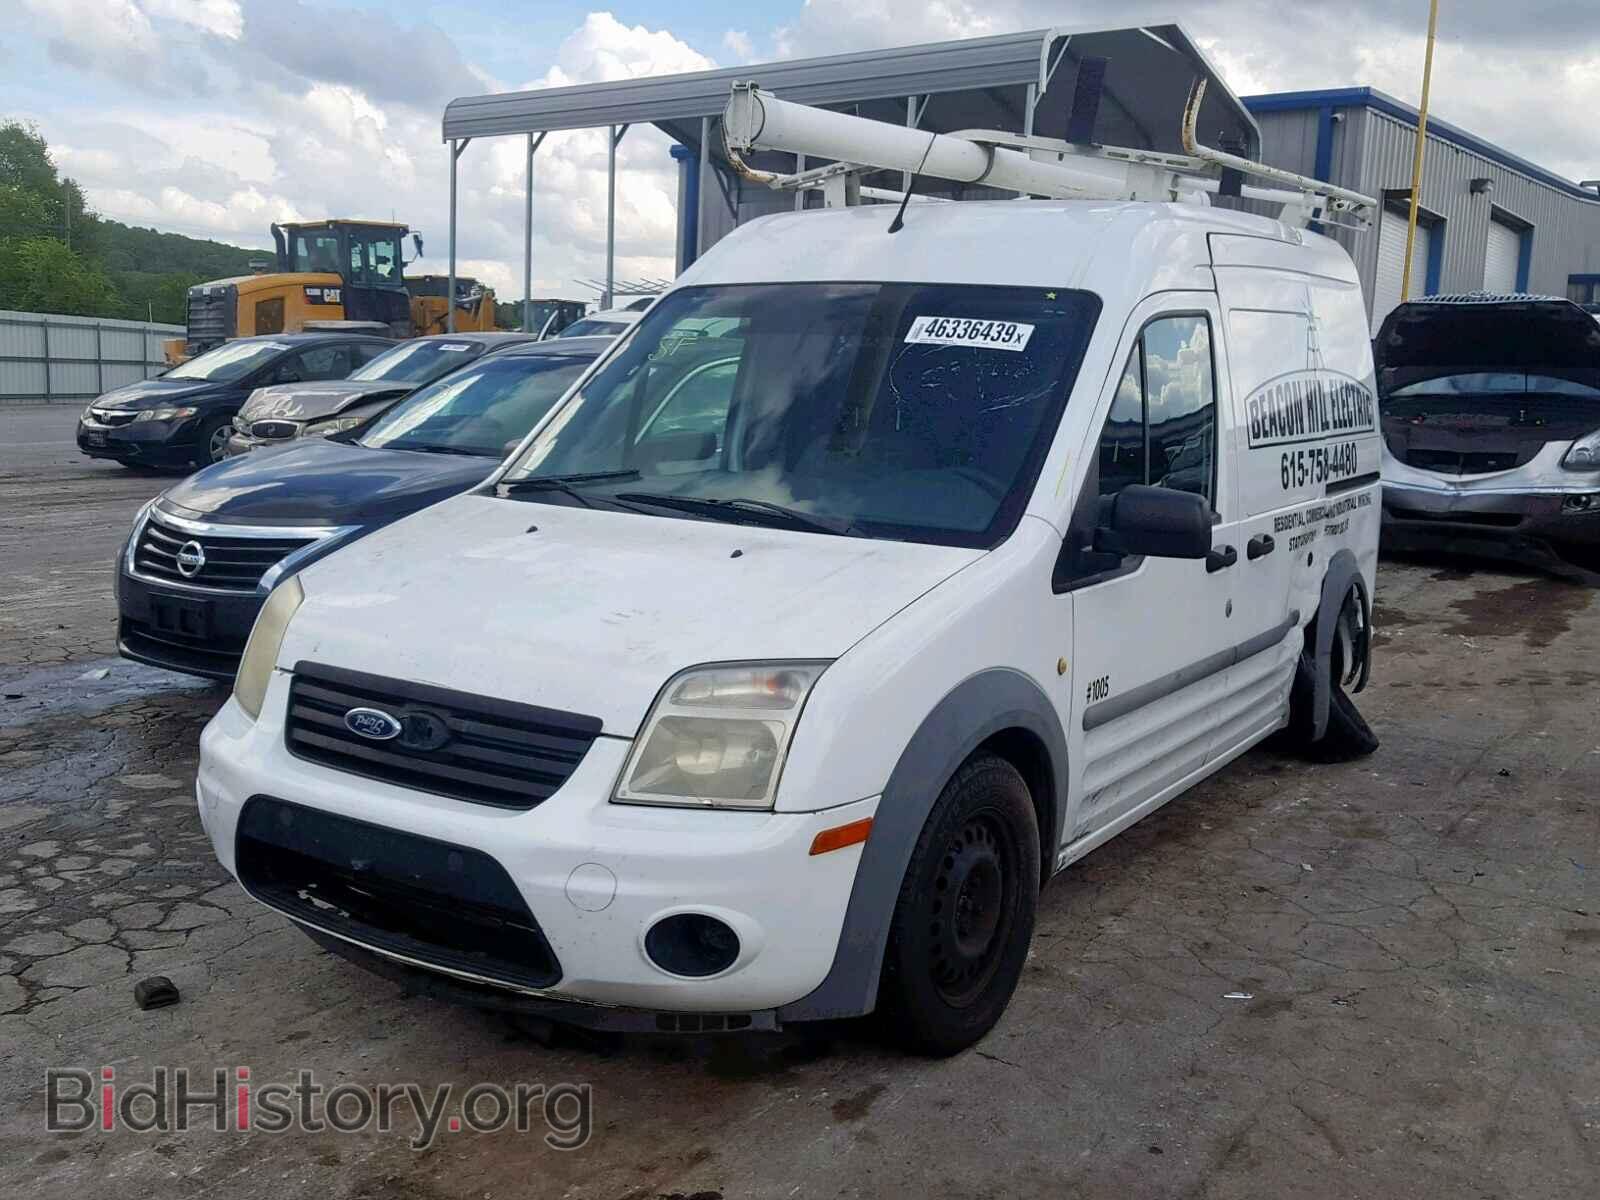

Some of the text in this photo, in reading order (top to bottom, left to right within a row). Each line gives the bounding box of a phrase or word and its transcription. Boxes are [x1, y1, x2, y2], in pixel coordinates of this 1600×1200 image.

[323, 288, 341, 302] CAT
[1250, 380, 1305, 440] BEACON
[1330, 379, 1373, 430] ELECTRIC
[1281, 442, 1358, 490] 615-758-4480
[1086, 675, 1109, 704] #1005
